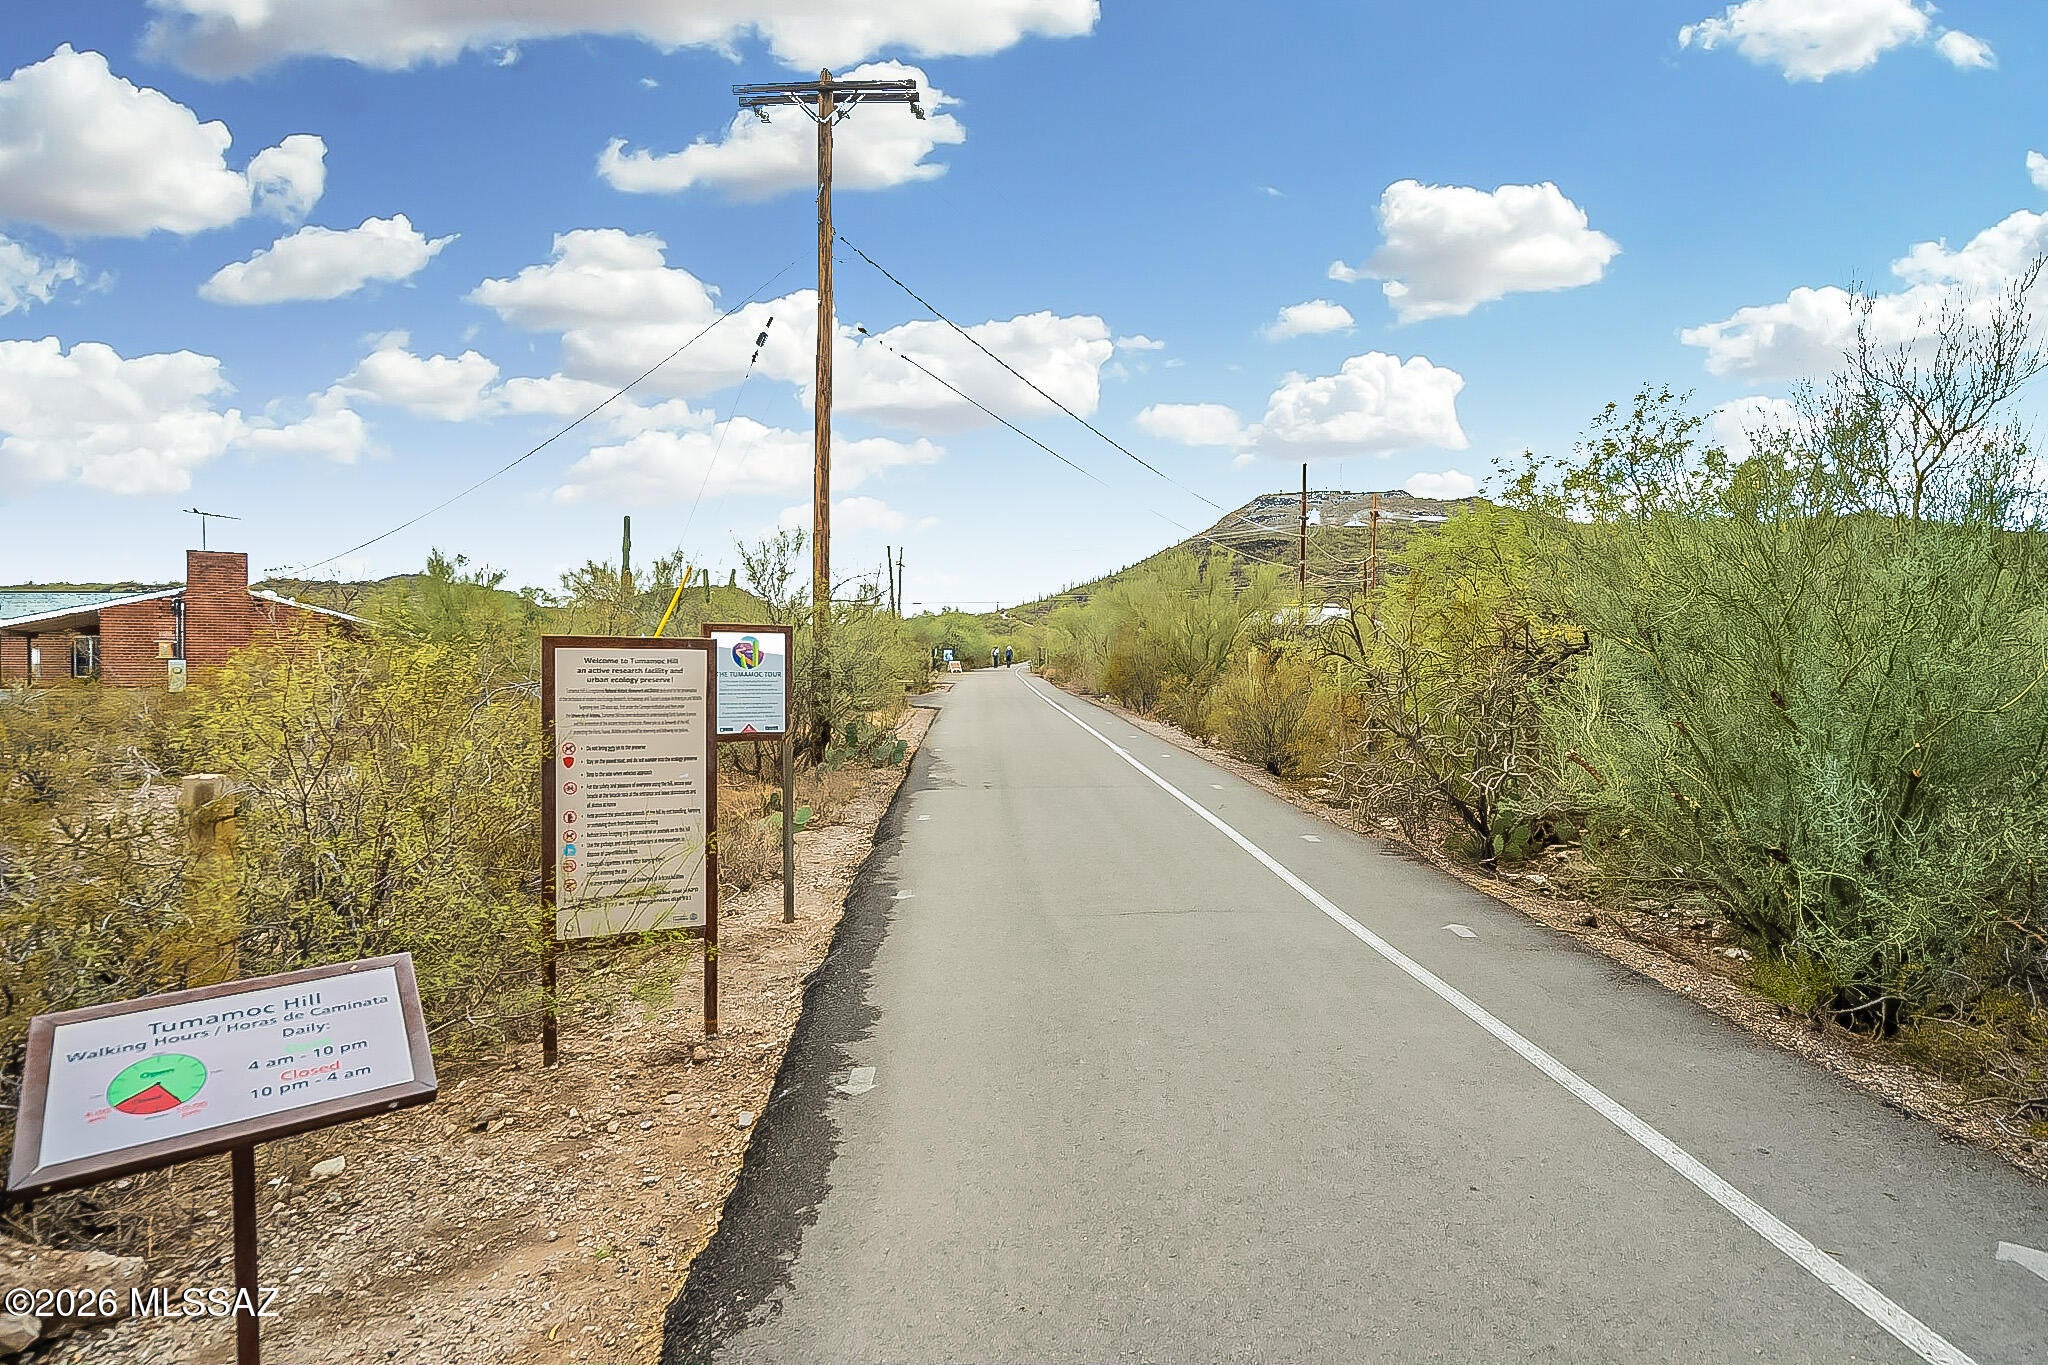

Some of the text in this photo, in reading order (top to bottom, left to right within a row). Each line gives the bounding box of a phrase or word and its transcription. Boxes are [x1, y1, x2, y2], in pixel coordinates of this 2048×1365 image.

[610, 677, 638, 685] ecology
[645, 667, 669, 676] facility
[148, 993, 321, 1035] Tumamoc Hill
[66, 1041, 147, 1062] Walking
[154, 1030, 209, 1047] Hours
[227, 1017, 278, 1032] Horas
[283, 1011, 304, 1021] de
[310, 996, 389, 1016] Caminata
[282, 1022, 331, 1038] Daily:
[248, 1060, 259, 1070] 4
[266, 1055, 294, 1067] am
[313, 1045, 334, 1058] 10
[340, 1039, 368, 1054] pm
[250, 1086, 272, 1099] 10
[279, 1080, 309, 1096] pm
[327, 1072, 338, 1081] 4
[344, 1066, 371, 1079] am
[280, 1060, 341, 1081] Closed
